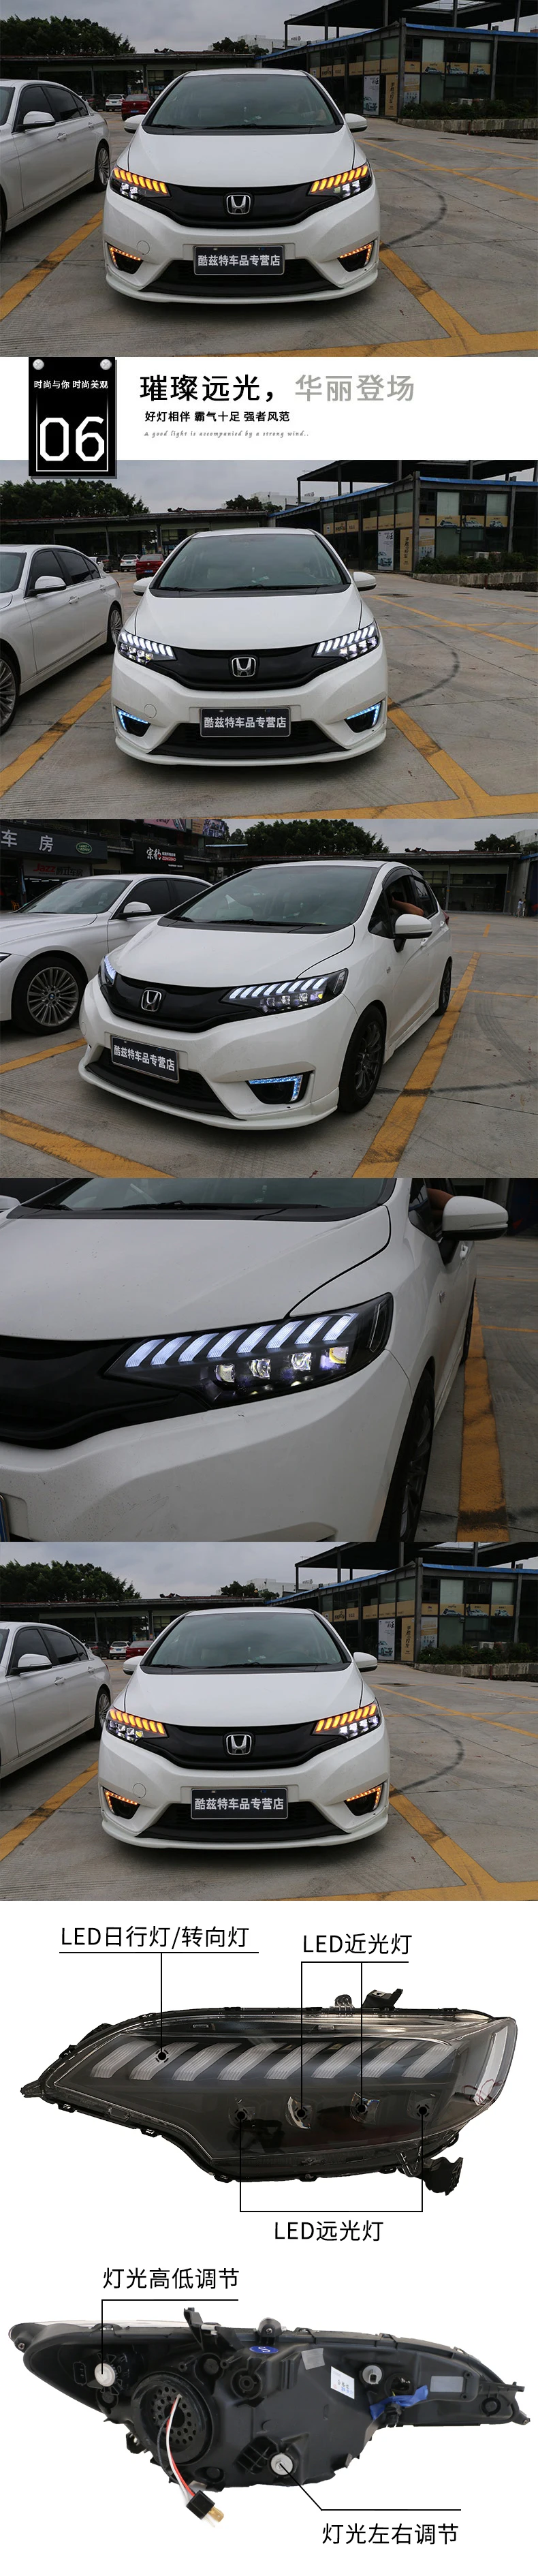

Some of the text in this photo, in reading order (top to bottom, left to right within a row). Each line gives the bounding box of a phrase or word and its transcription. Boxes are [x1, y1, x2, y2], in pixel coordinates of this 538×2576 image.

[198, 254, 280, 266] 酷兹特车品专营店
[204, 716, 286, 728] 酷兹特车品专营店
[33, 863, 56, 873] Jazz
[114, 1044, 175, 1072] 酷兹特车品专营店
[195, 1797, 284, 1810] 酷兹特车品专营店
